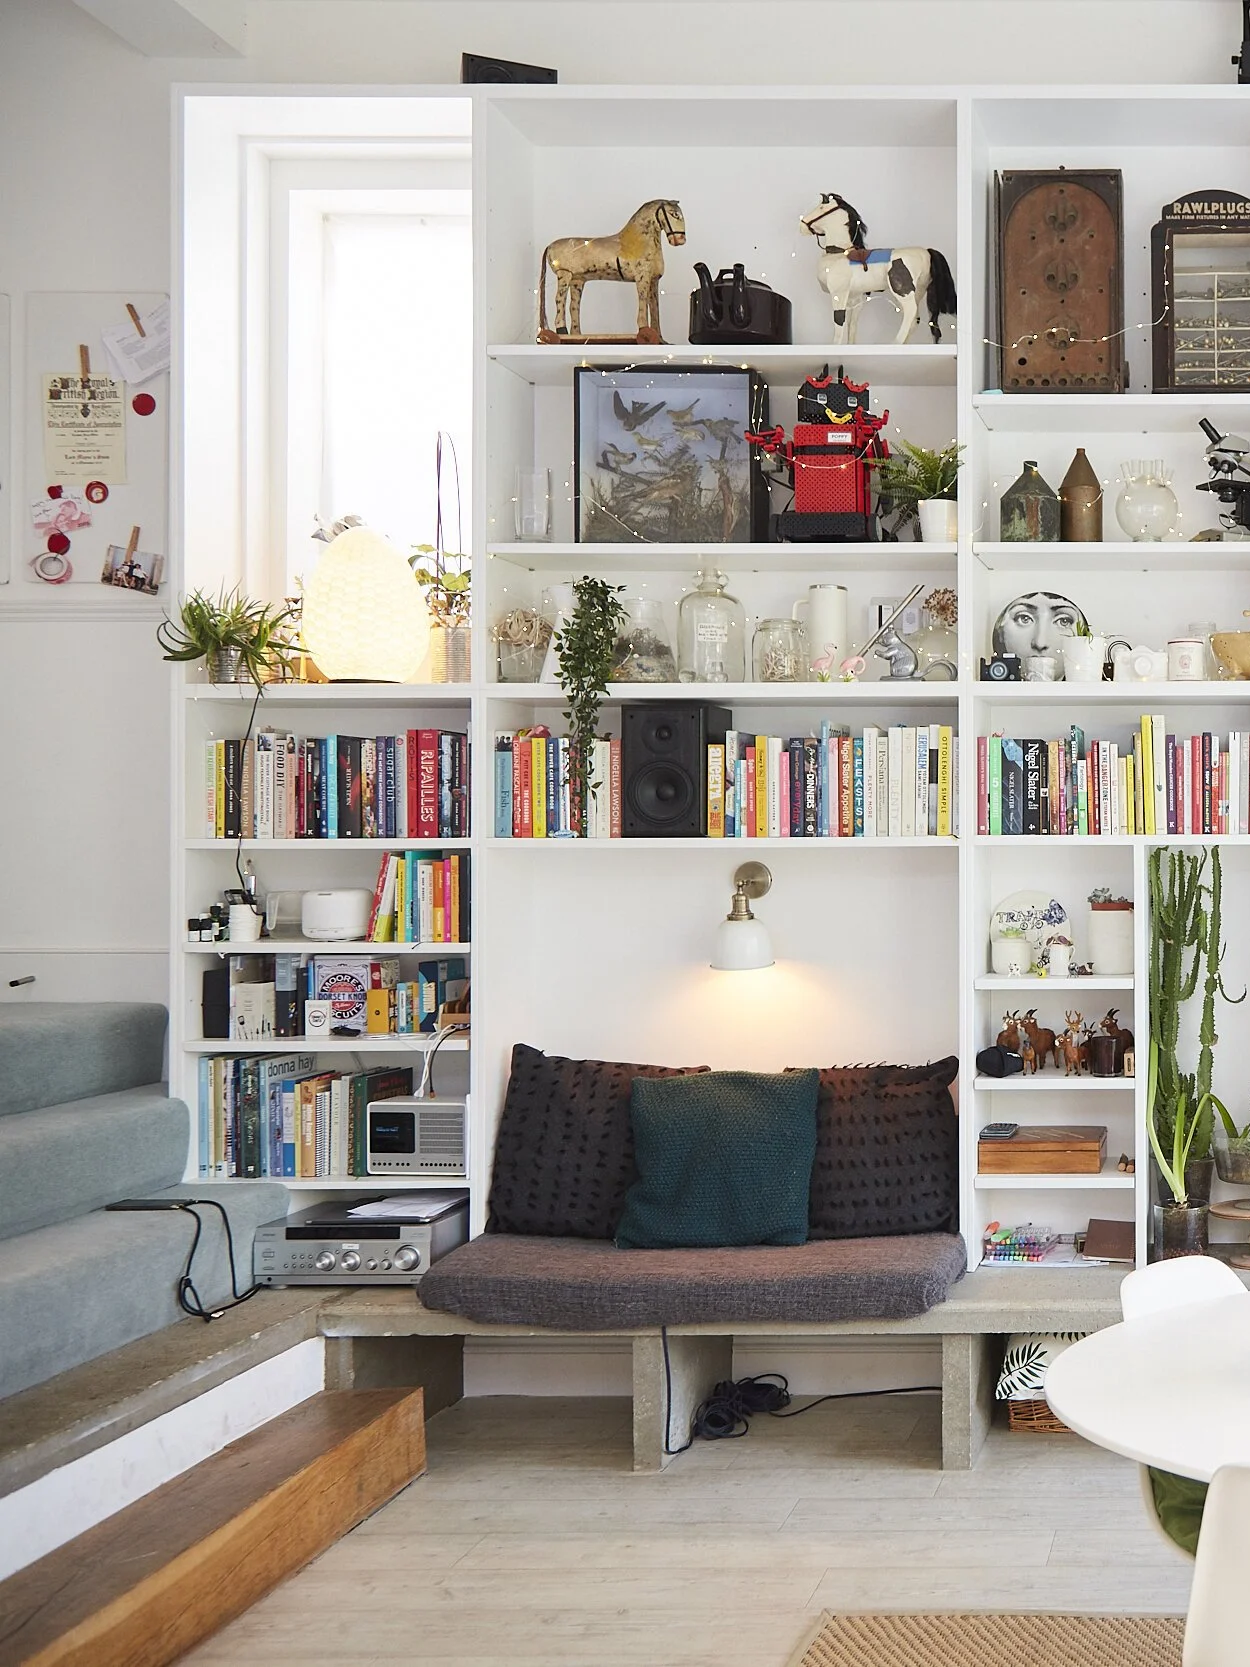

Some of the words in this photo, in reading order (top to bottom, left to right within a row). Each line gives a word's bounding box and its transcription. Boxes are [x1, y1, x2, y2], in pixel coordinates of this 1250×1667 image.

[386, 748, 394, 778] sugar
[841, 741, 850, 761] Nigel
[918, 735, 927, 769] JERUSALEM
[1025, 743, 1039, 769] Nigel
[386, 780, 395, 802] club
[421, 750, 434, 822] RIPAILLES
[806, 774, 815, 808] DINNERS
[992, 777, 998, 788] 5
[1028, 771, 1039, 800] Slater
[501, 790, 509, 808] Fish
[792, 781, 801, 824] everyday
[841, 789, 850, 824] Appetite
[322, 974, 365, 992] MOORES
[267, 1060, 295, 1077] donna
[298, 1055, 315, 1072] hay
